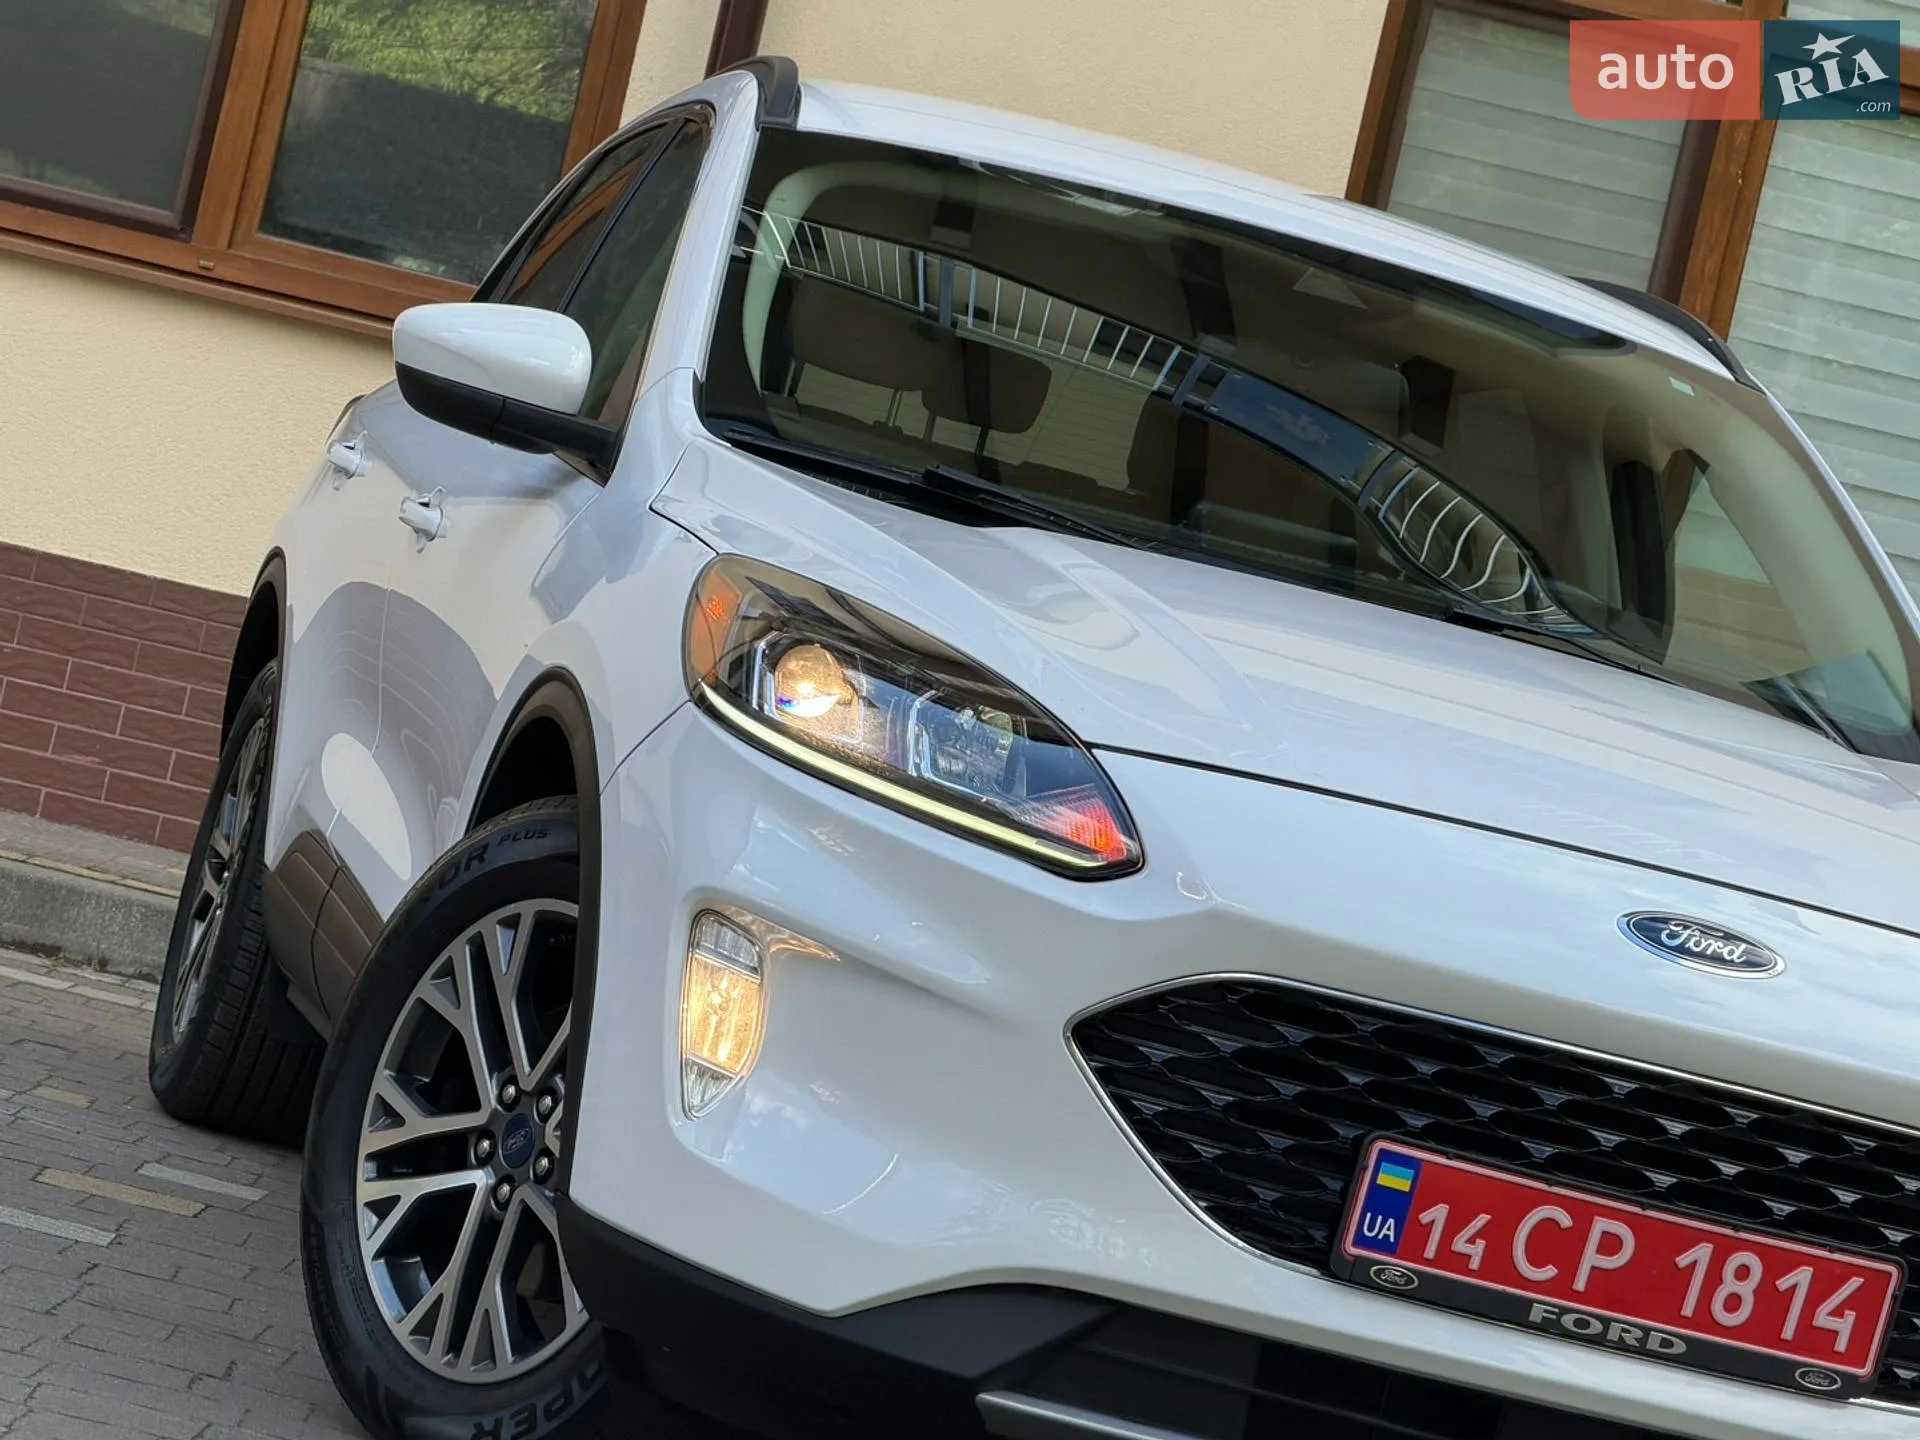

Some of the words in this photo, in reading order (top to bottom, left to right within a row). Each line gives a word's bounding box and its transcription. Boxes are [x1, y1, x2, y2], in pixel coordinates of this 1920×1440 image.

[497, 828, 551, 847] PLUS
[1661, 919, 1748, 963] Ford
[1363, 1212, 1396, 1243] UA
[1418, 1203, 1492, 1272] 14
[1511, 1205, 1636, 1293] CP
[1674, 1242, 1866, 1355] 1814
[1380, 1269, 1408, 1285] Ford
[1527, 1302, 1688, 1355] FORD
